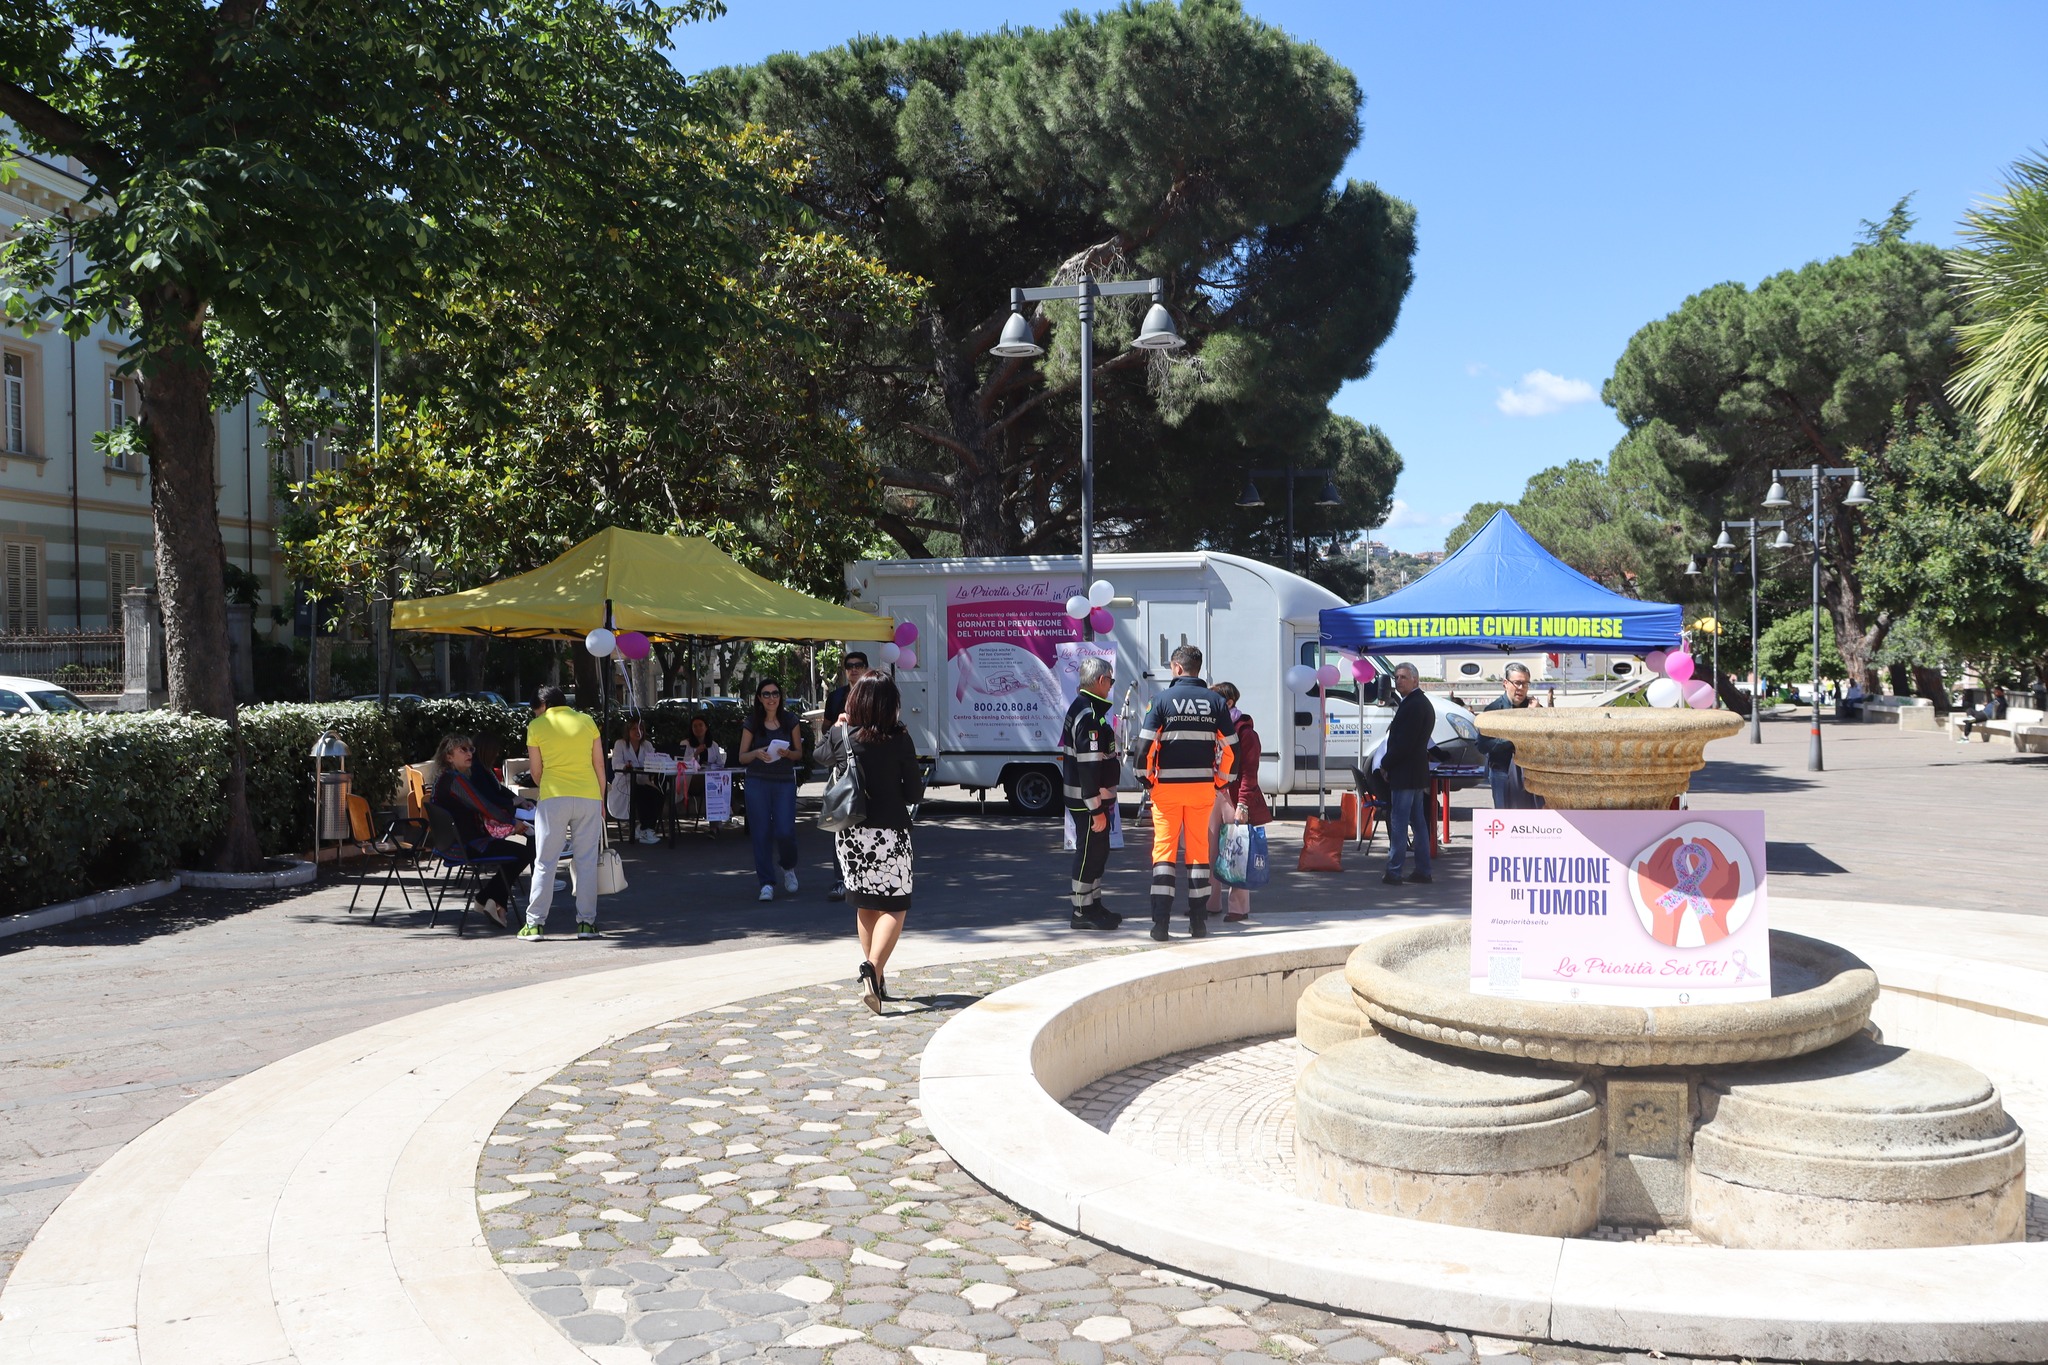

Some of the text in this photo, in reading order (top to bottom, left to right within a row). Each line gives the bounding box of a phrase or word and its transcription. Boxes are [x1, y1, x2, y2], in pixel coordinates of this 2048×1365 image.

[955, 581, 1050, 599] La Priorità Sei Tu!
[957, 619, 1062, 628] GIORNATE DI PREVENZIONE
[1374, 616, 1623, 638] PROTEZIONE CIVILE NUORESE
[957, 628, 1078, 638] DEL TUMORE DELLA MAMMELLA
[1059, 647, 1116, 659] La Priorità
[973, 702, 1039, 712] 800.20.80.84
[1172, 698, 1212, 715] VAB
[1166, 715, 1217, 724] PROTEZIONE CIVILE
[1511, 825, 1563, 834] ASLNuoro
[1488, 856, 1611, 884] PREVENZIONE
[1510, 888, 1608, 916] DEI TUMORI
[1552, 956, 1729, 978] La Priorità Sei Tu!
